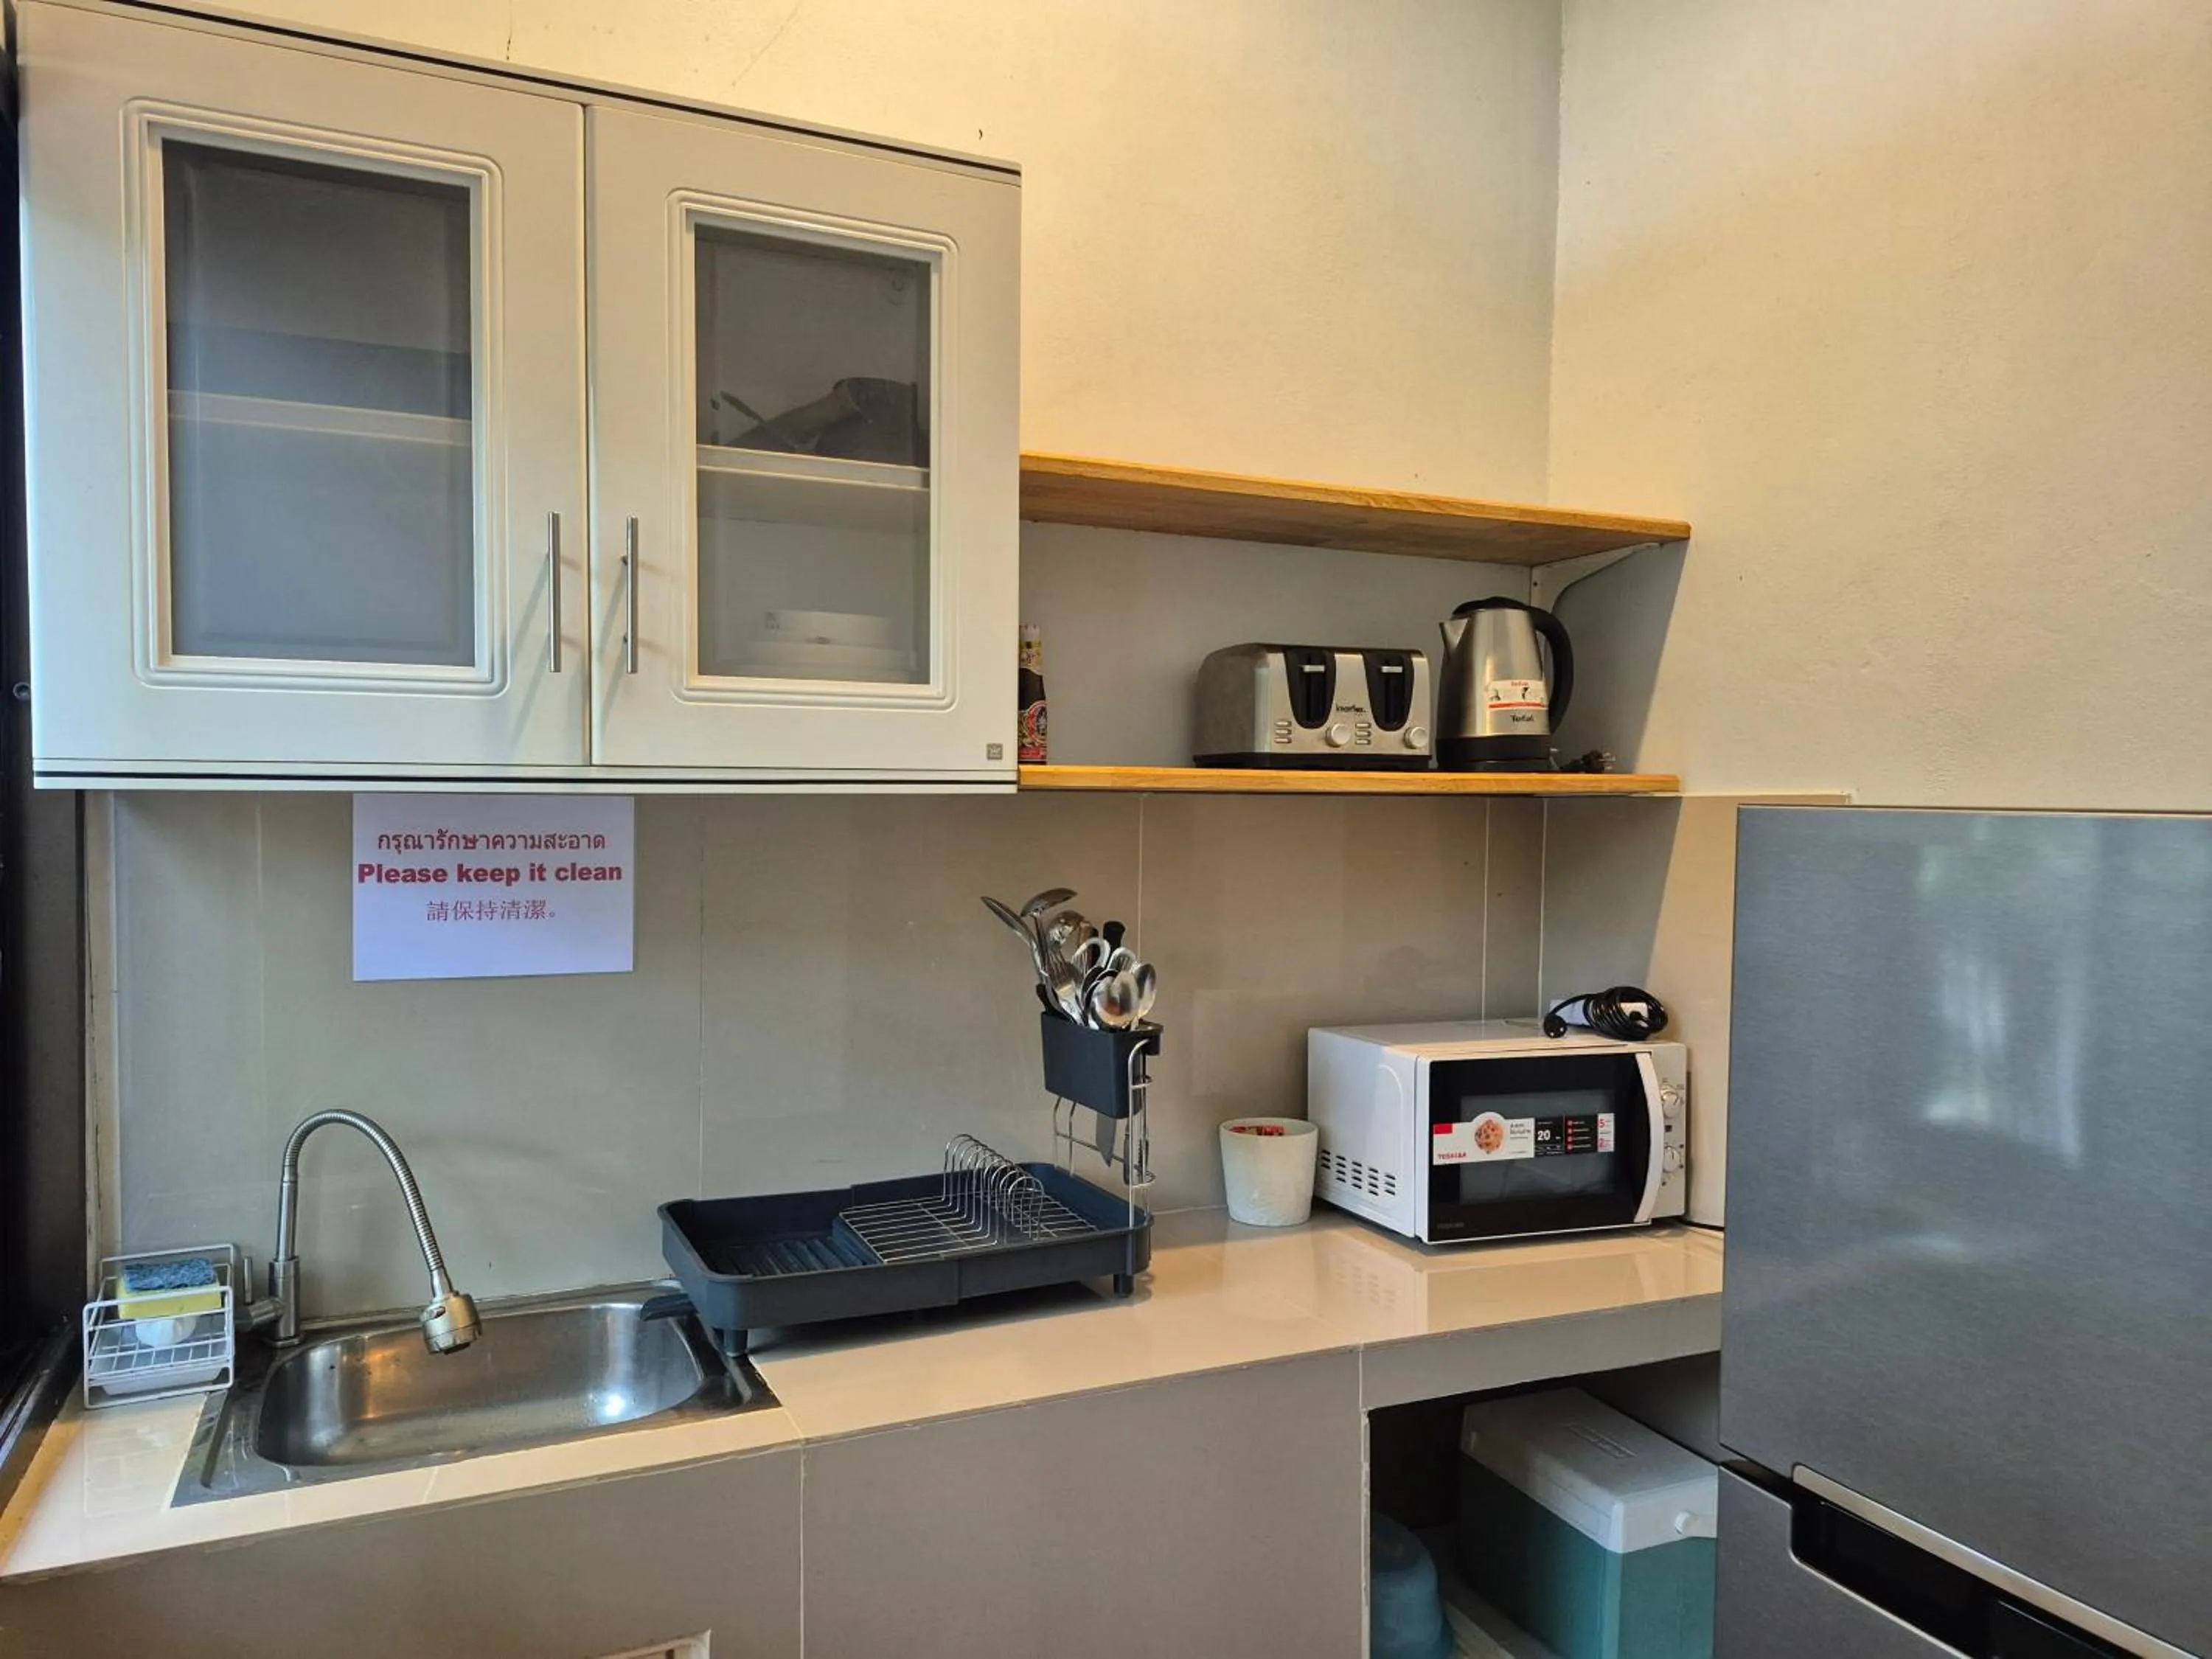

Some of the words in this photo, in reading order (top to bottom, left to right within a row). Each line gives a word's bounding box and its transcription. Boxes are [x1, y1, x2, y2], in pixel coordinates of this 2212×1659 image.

[378, 829, 605, 854] กรุณารักษาความสะอาด
[358, 863, 448, 883] Please
[456, 863, 521, 886] keep
[529, 863, 546, 882] it
[554, 862, 622, 881] clean
[1537, 1130, 1551, 1141] 20
